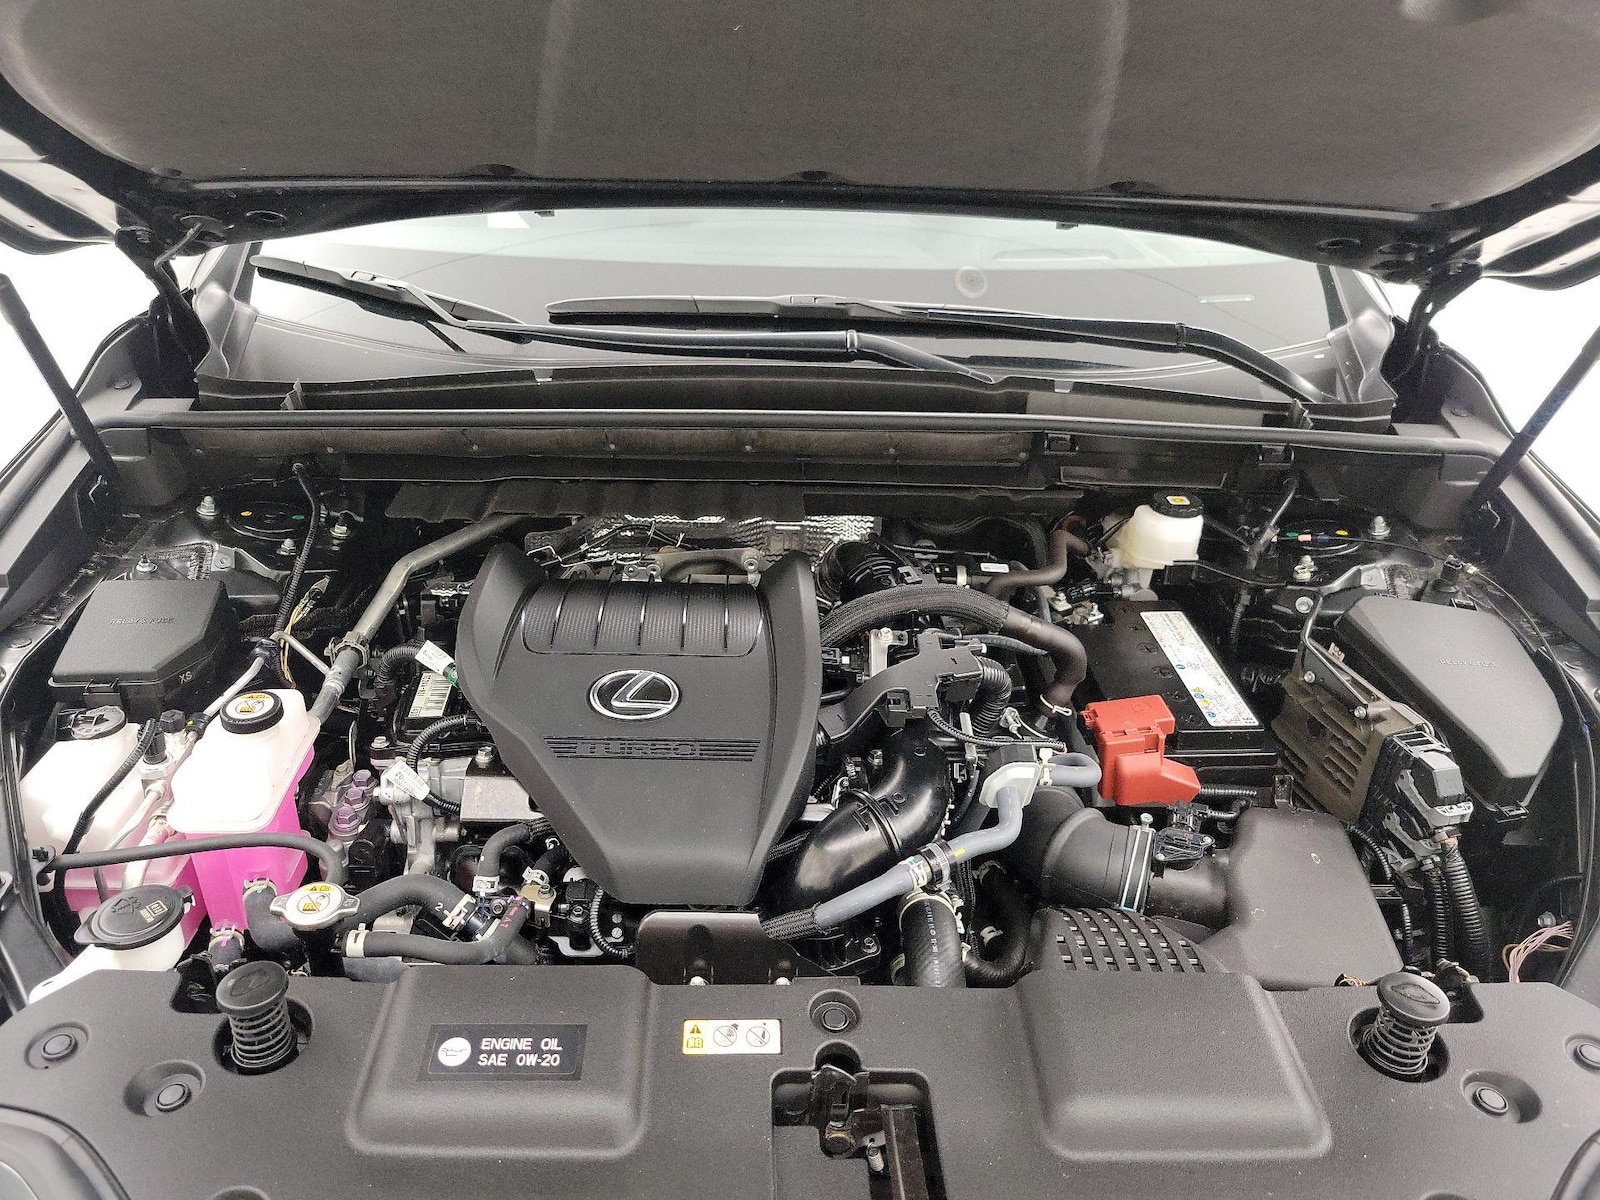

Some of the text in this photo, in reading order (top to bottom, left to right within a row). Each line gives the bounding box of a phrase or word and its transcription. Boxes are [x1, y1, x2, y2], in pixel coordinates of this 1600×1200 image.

[581, 741, 697, 756] TURBO
[480, 1037, 563, 1051] ENGINE OIL
[477, 1053, 561, 1067] SAE 0W-20
